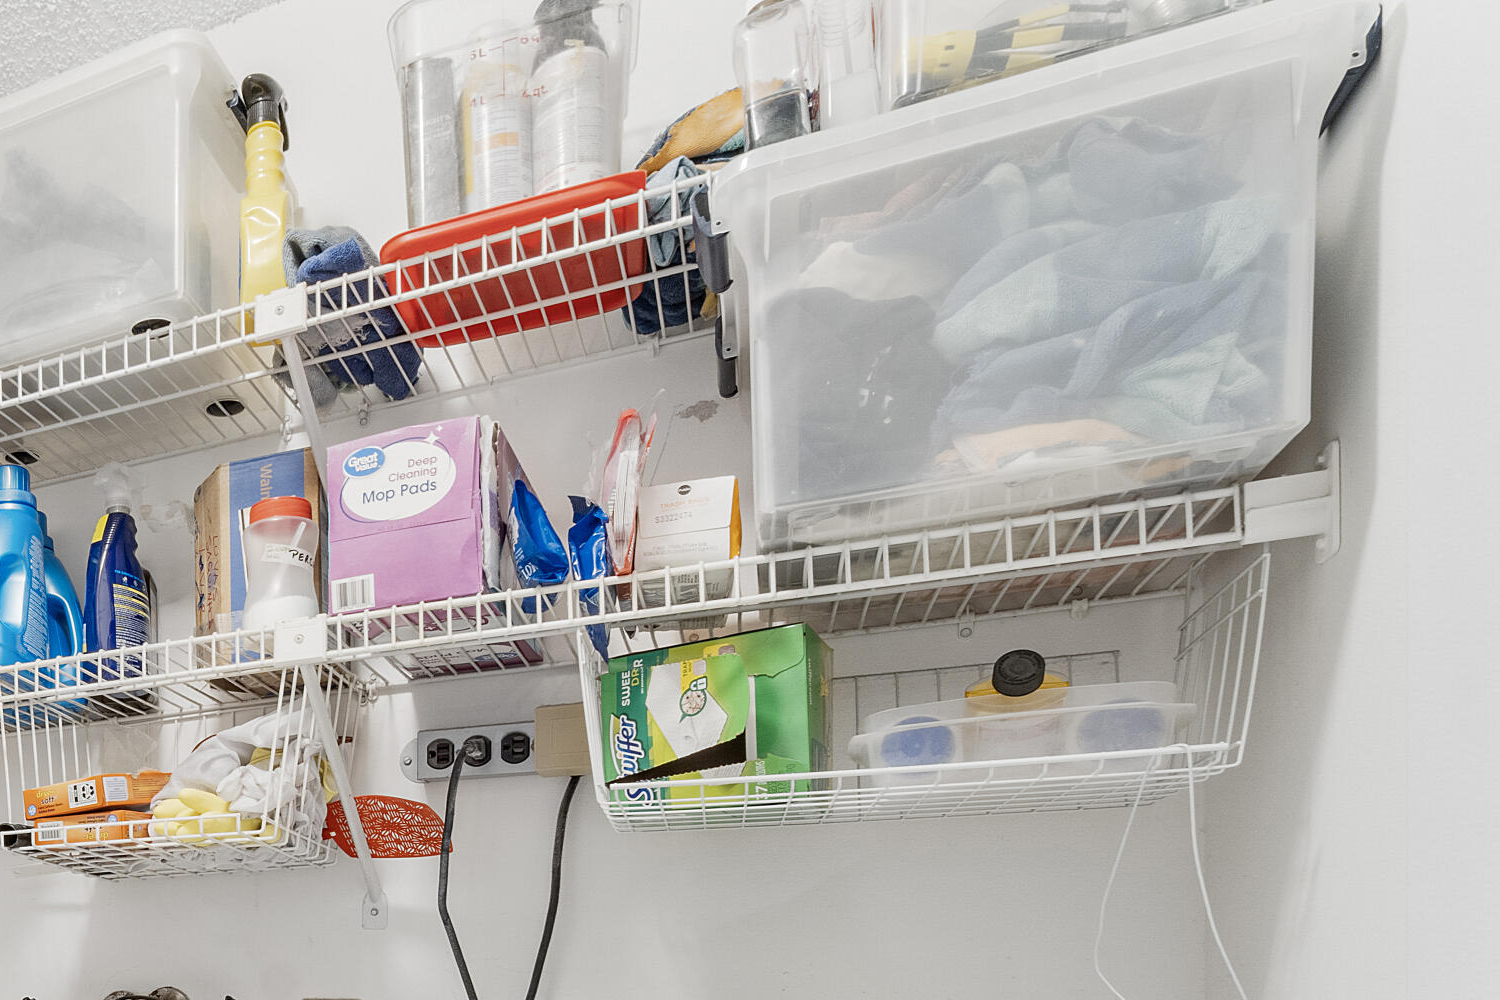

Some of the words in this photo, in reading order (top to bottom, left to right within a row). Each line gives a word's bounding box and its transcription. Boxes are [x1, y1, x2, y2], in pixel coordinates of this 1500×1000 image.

[347, 451, 379, 468] Great
[407, 456, 438, 469] Deep
[388, 467, 438, 482] Cleaning
[362, 490, 395, 505] Mop
[400, 480, 438, 497] Pads
